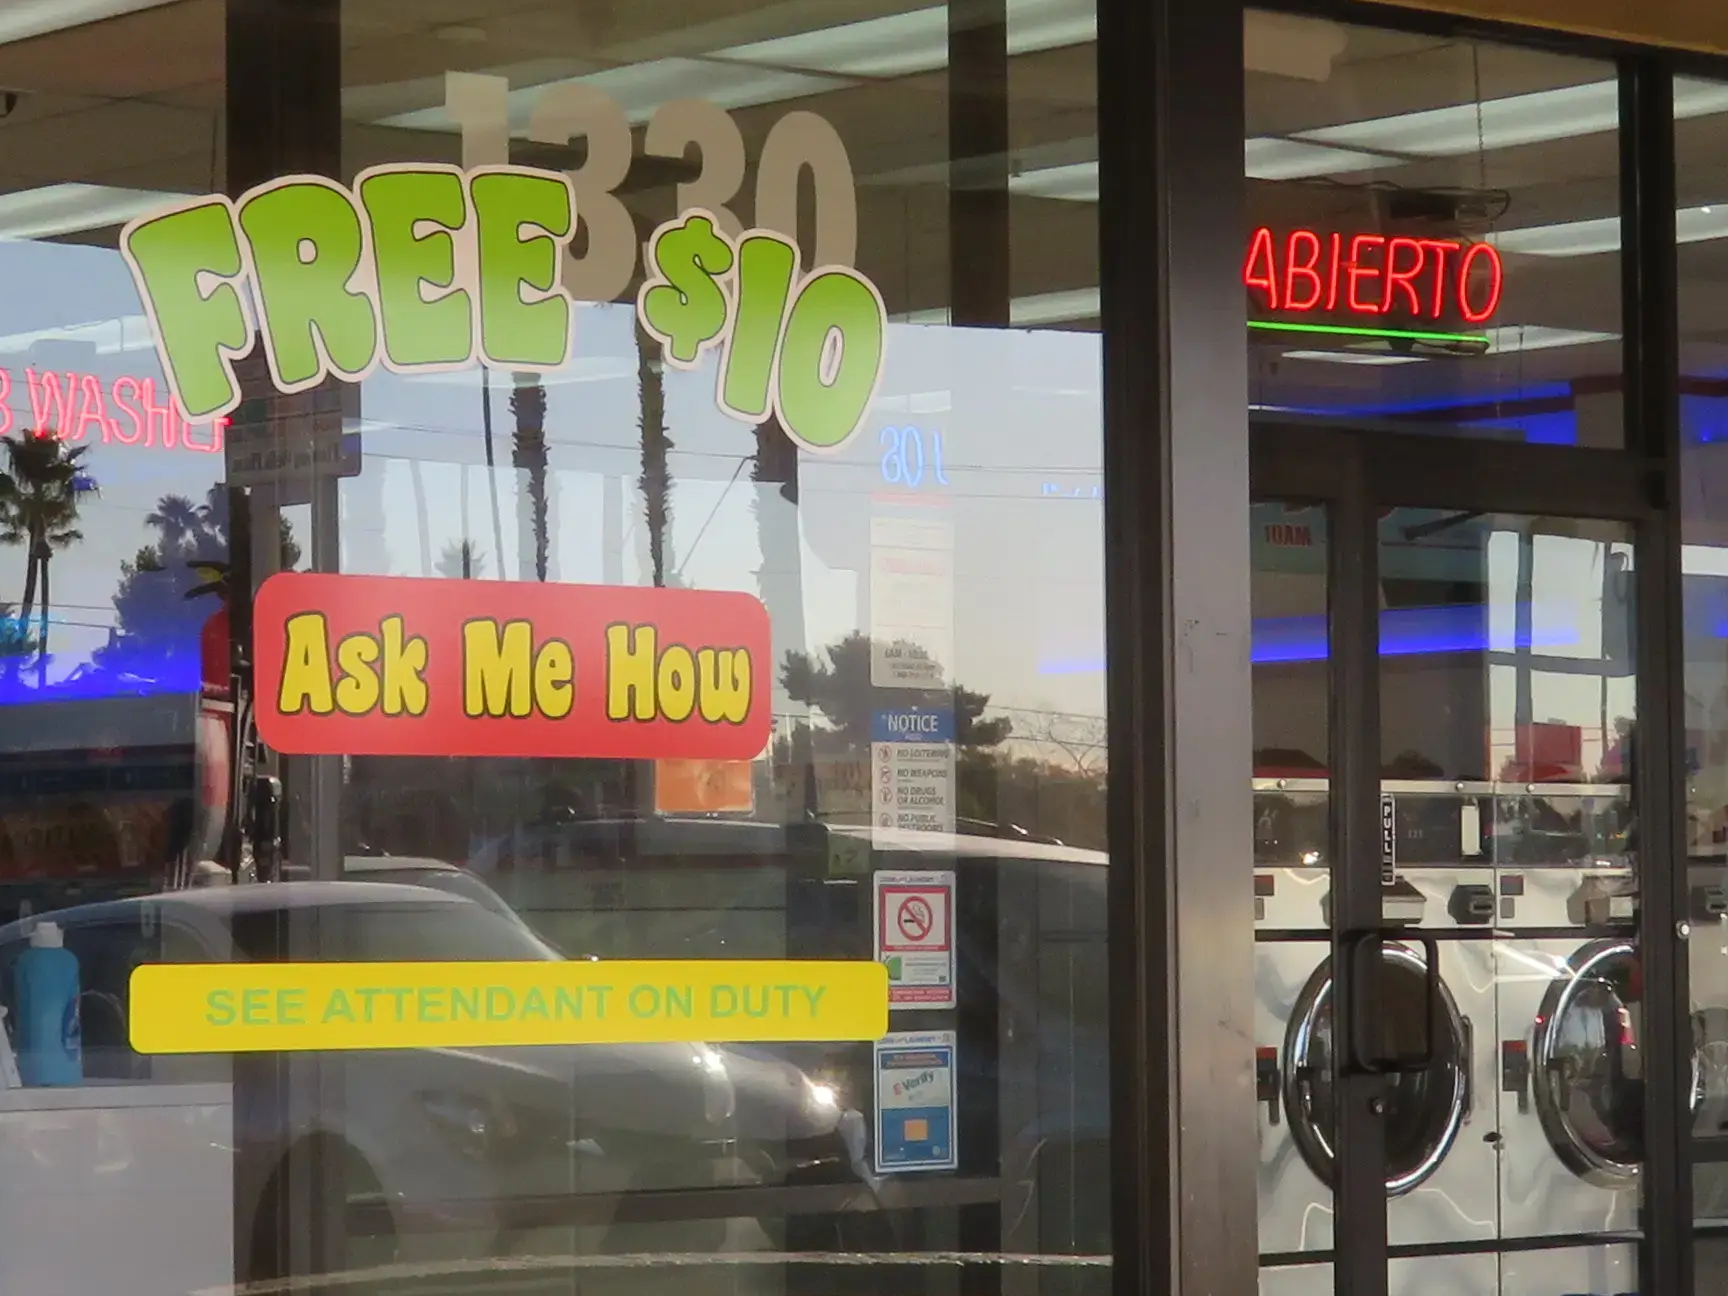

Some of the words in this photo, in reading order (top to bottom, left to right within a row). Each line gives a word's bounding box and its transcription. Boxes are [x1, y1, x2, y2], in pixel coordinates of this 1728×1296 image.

[119, 162, 578, 423] FREE
[636, 208, 888, 455] $10
[1243, 227, 1504, 324] ABIERTO
[277, 611, 431, 718] Ask
[462, 617, 576, 721] Me
[604, 623, 754, 725] How
[887, 714, 940, 734] NOTICE
[1383, 805, 1392, 853] PULL
[205, 988, 308, 1027] SEE
[321, 984, 609, 1025] ATTENDANT
[627, 983, 693, 1021] ON
[709, 982, 829, 1019] DUTY
